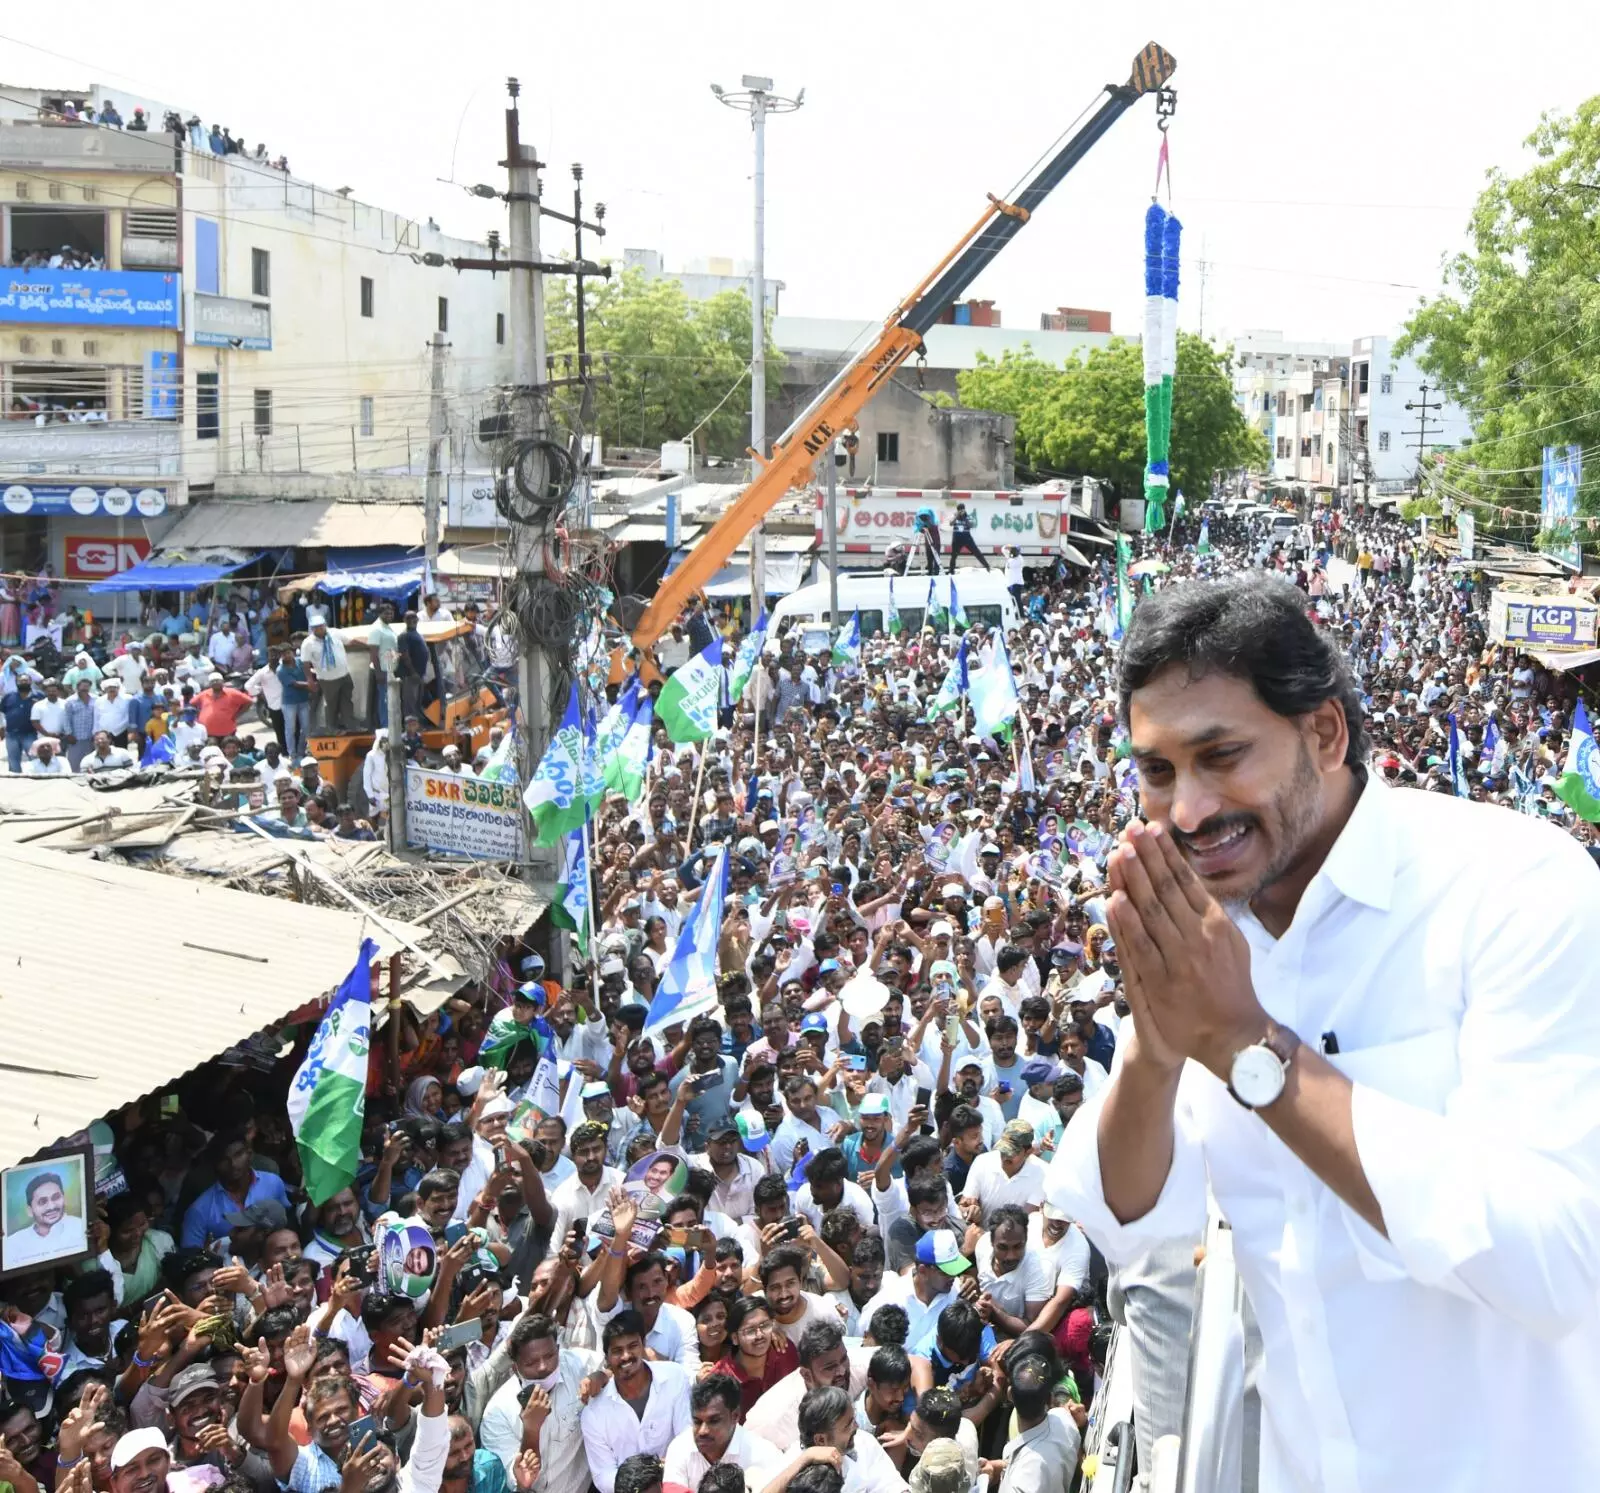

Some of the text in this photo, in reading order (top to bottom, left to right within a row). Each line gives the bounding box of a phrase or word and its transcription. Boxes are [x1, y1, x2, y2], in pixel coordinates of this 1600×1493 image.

[802, 420, 836, 457] ACE
[1531, 608, 1573, 625] KCP
[316, 741, 339, 751] ACE
[425, 778, 461, 801] SKR
